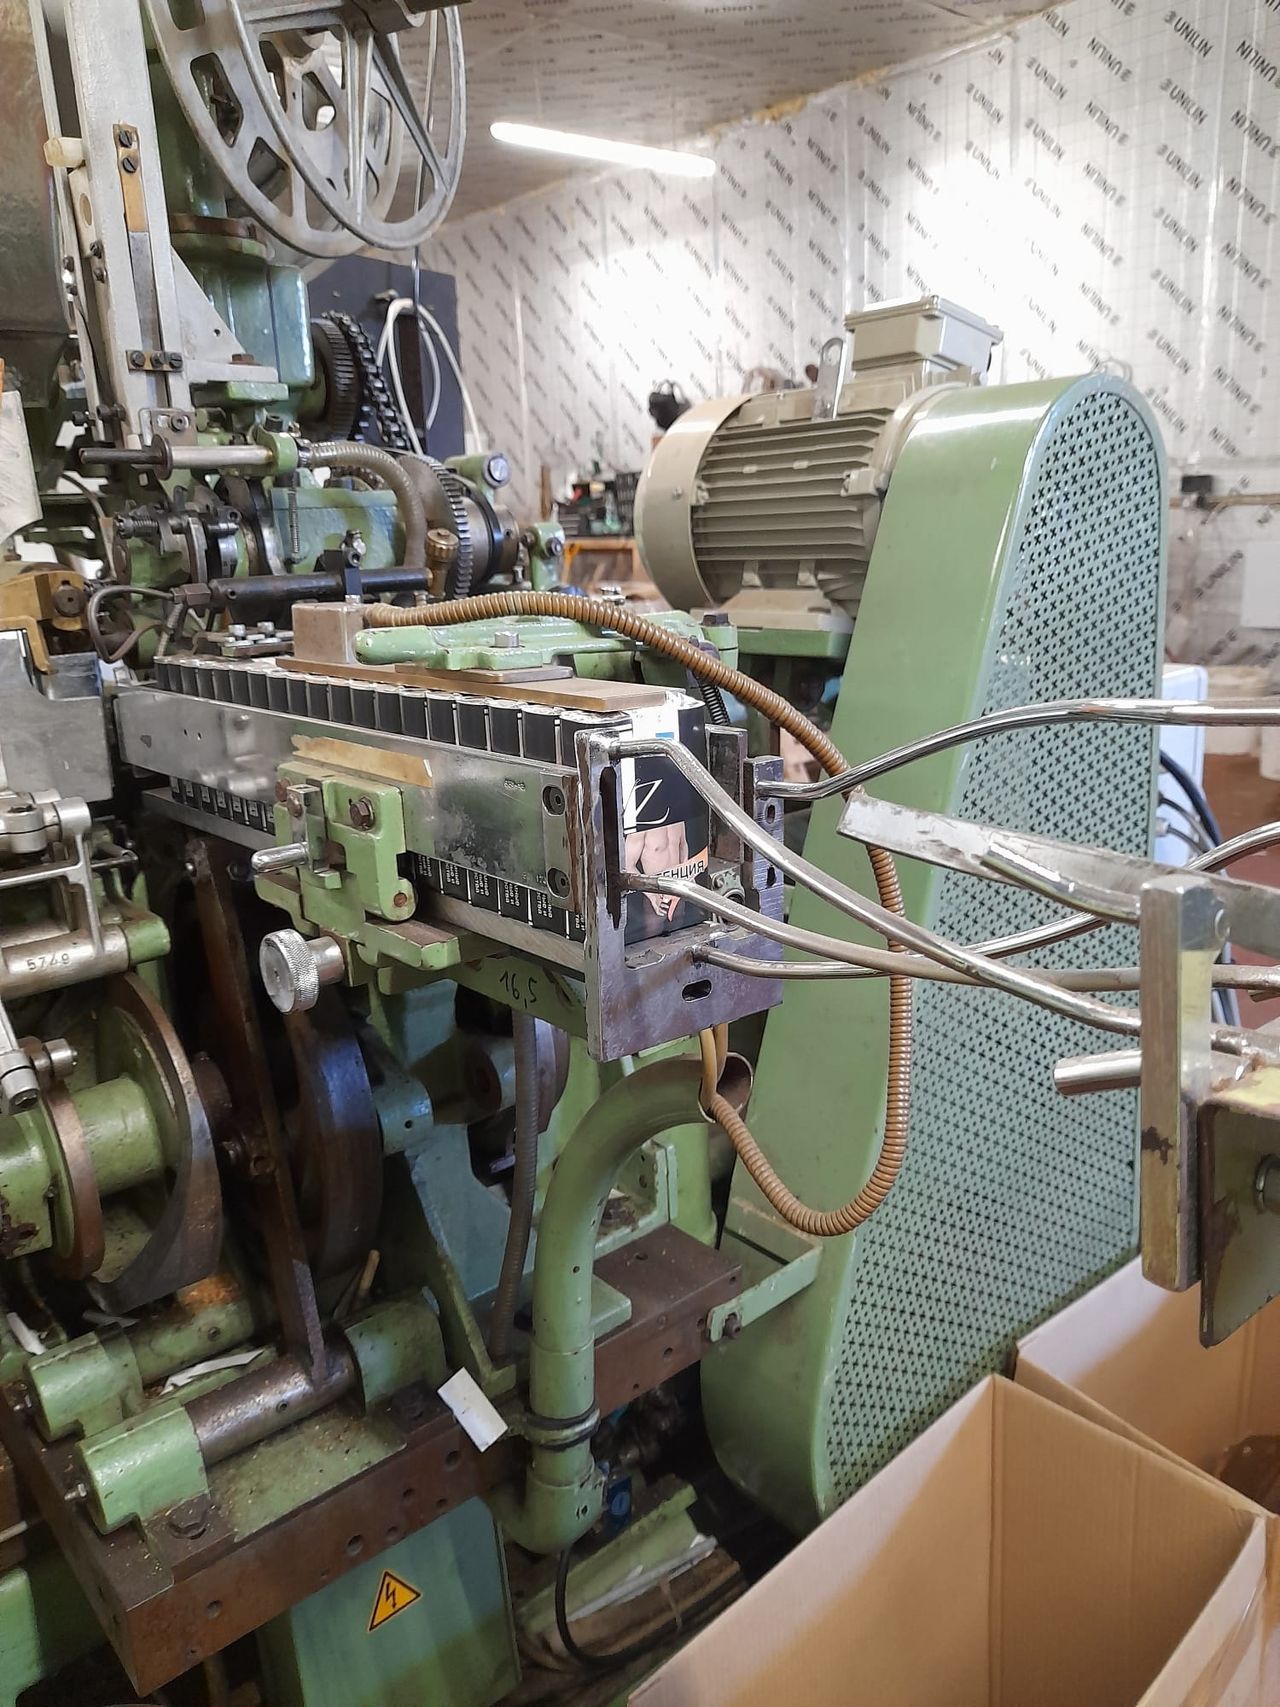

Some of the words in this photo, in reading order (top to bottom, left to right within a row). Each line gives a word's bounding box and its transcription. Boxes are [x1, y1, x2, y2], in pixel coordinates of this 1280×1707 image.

[1087, 37, 1123, 76] UNILIN
[1173, 17, 1214, 58] UNILIN
[1235, 40, 1278, 82] UNILIN
[1034, 63, 1068, 100] UNILIN
[1084, 100, 1120, 139] UNILIN
[1169, 85, 1208, 125] UNILIN
[1230, 110, 1272, 151] UNILIN
[1166, 150, 1203, 190] UNILIN
[1162, 213, 1199, 253] UNILIN
[655, 859, 705, 880] ЕНЦИЯ
[499, 970, 538, 1009] 16,5
